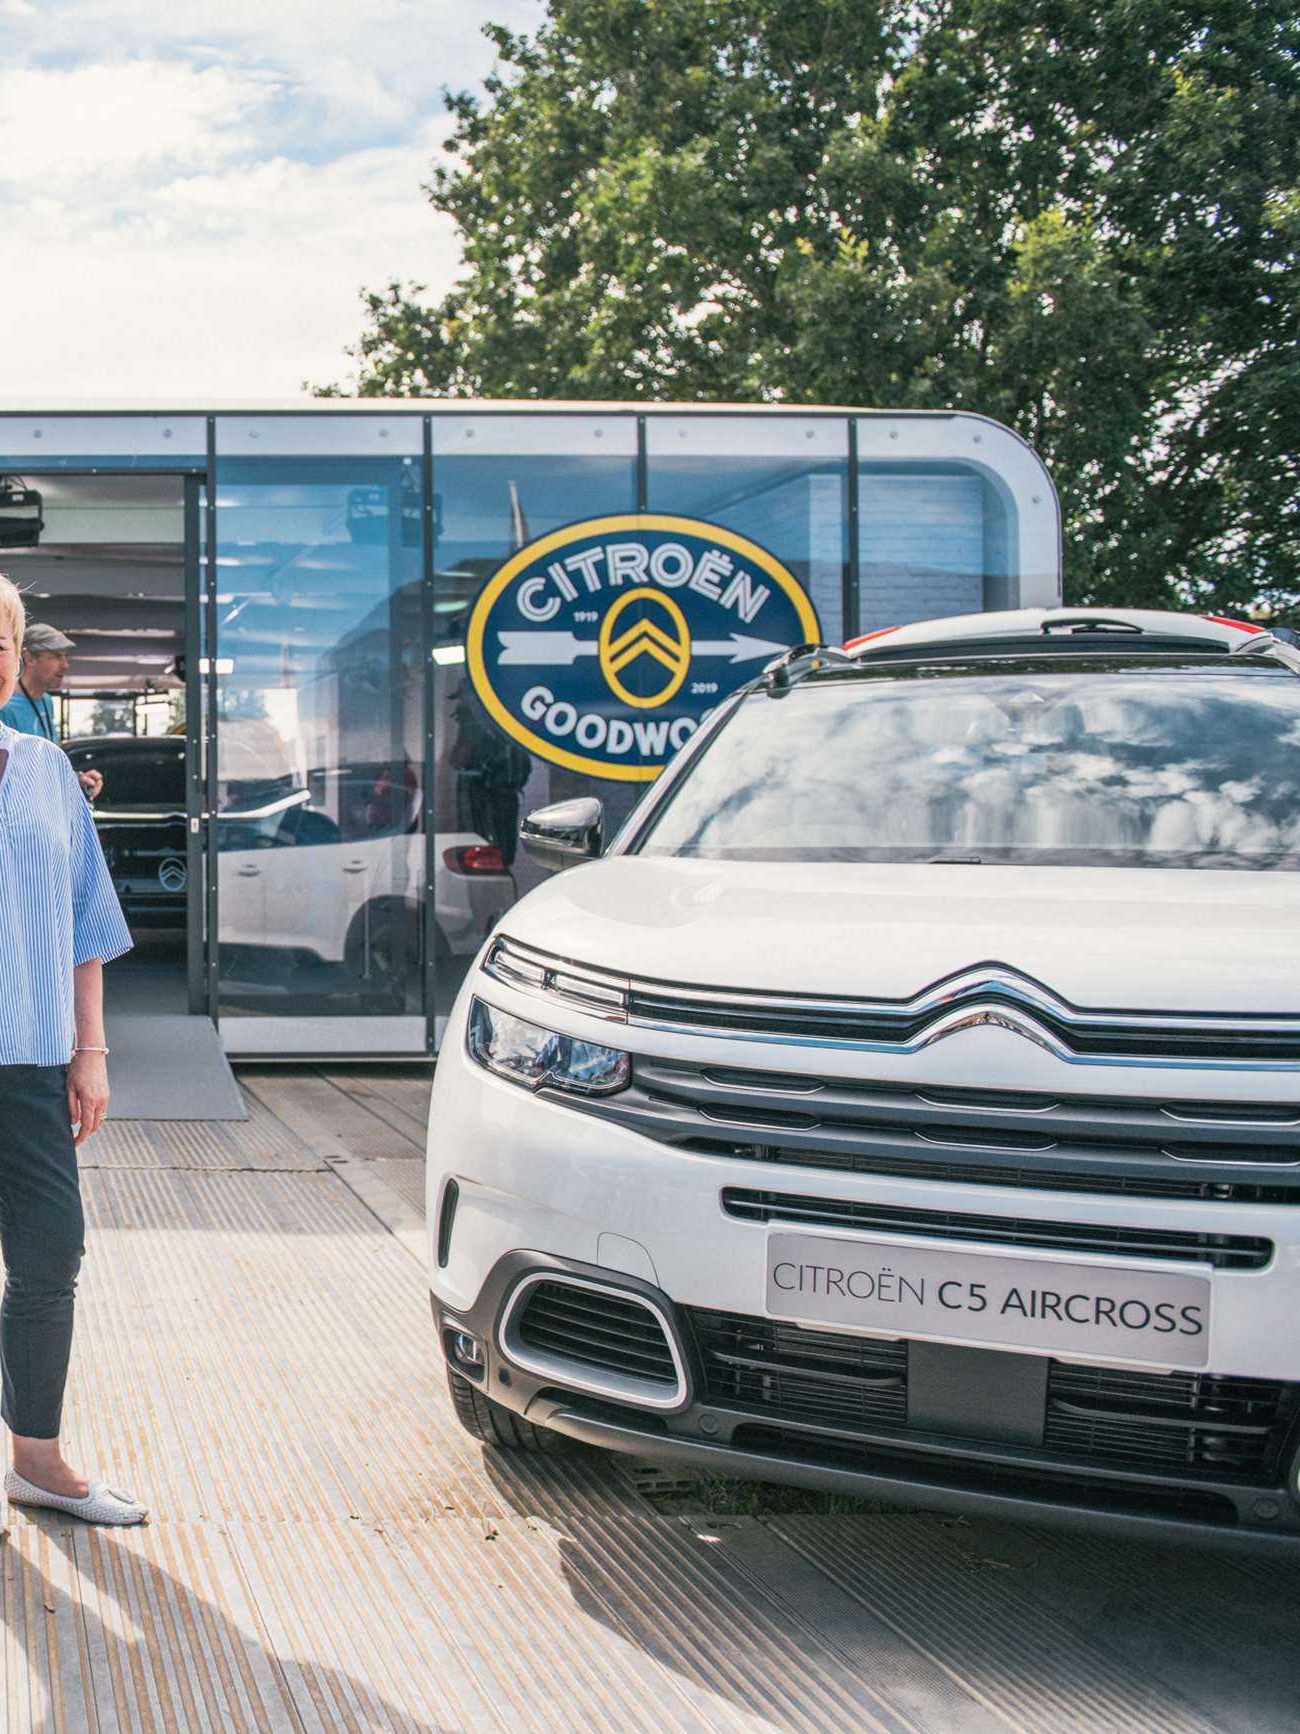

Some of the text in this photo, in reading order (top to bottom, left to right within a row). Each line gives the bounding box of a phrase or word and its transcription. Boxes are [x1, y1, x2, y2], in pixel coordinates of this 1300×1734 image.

[516, 542, 770, 624] CITROËN
[573, 611, 599, 622] 1919
[520, 685, 715, 756] GOODWO
[691, 682, 718, 694] 2019
[772, 1261, 1203, 1336] CITROËN C5 AIRCROSS
